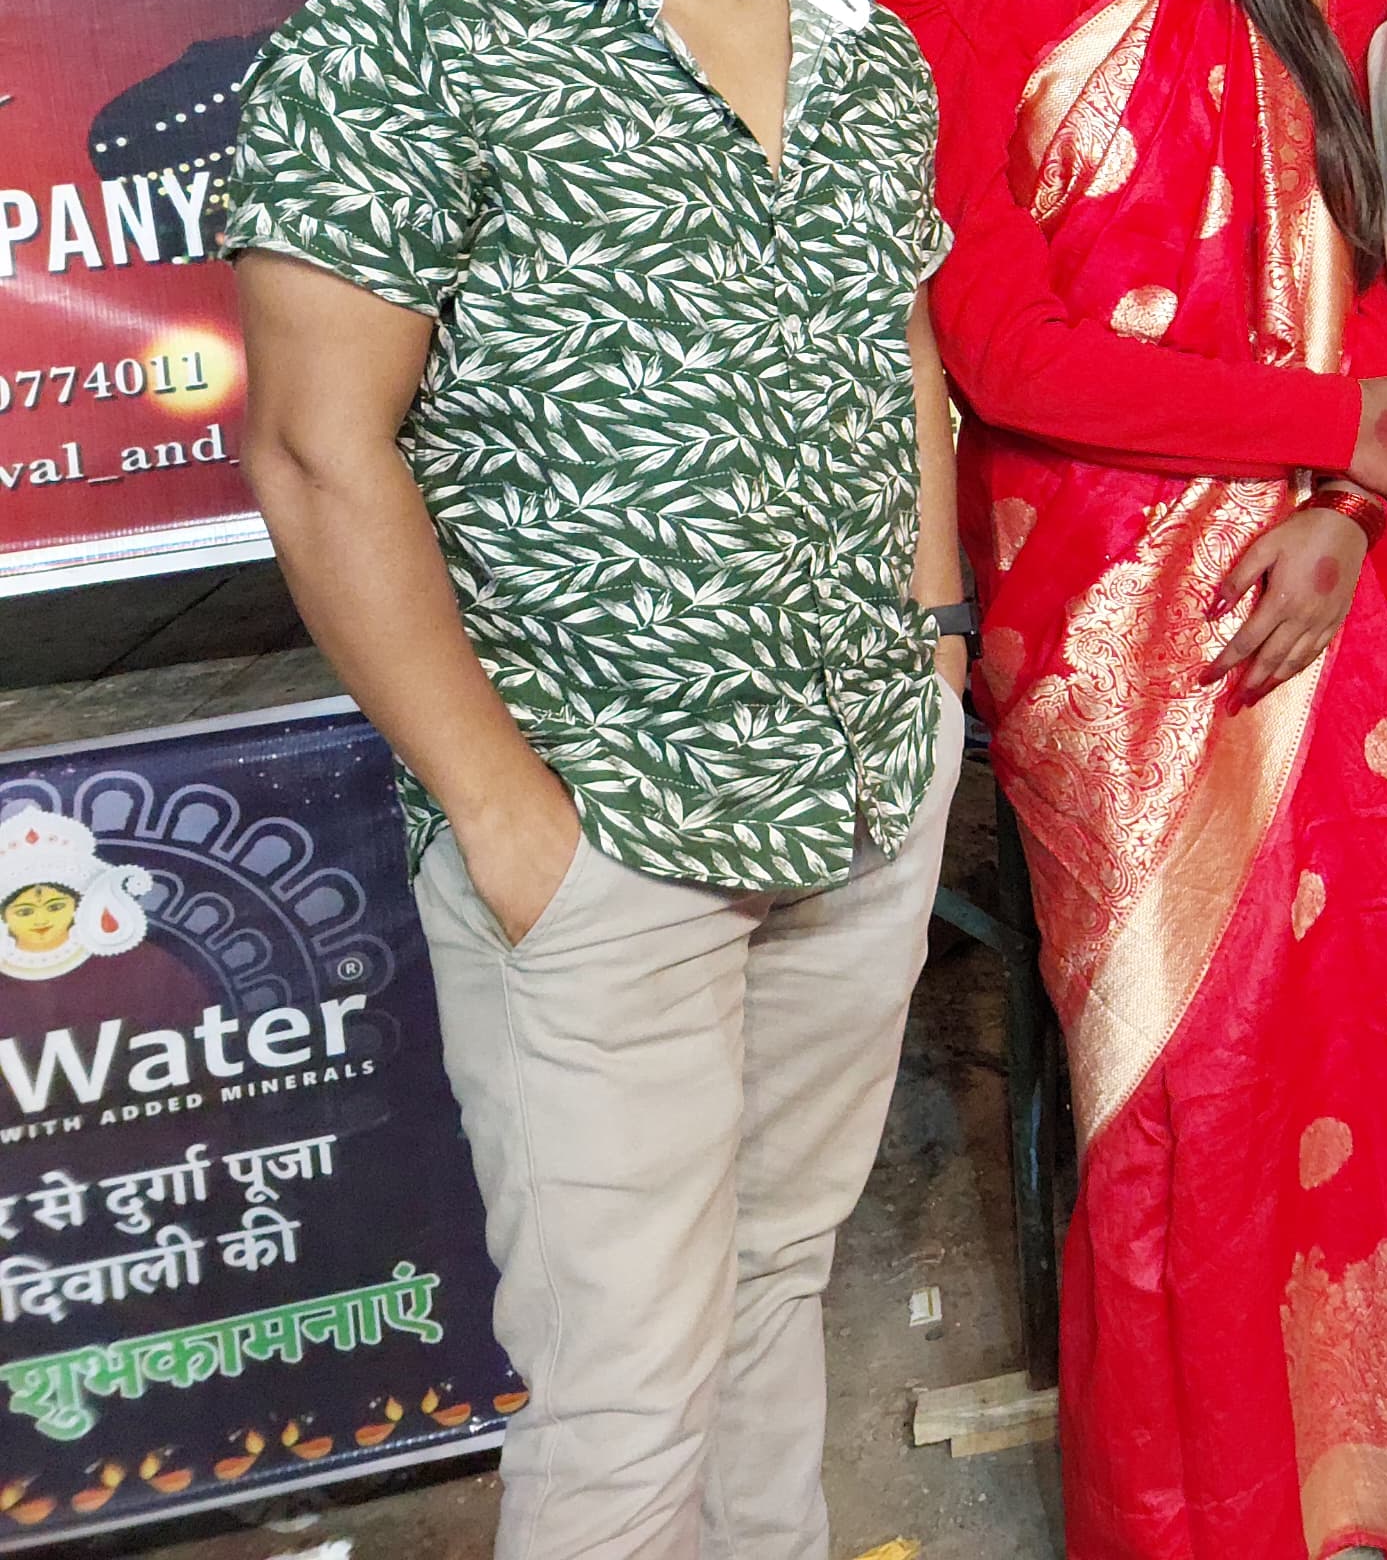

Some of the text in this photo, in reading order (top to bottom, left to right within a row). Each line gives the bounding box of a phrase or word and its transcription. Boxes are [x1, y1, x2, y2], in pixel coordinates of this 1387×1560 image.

[0, 171, 210, 279] PANY
[0, 992, 367, 1114] Water
[0, 1059, 375, 1143] WITH ADDED MINERALS
[27, 1170, 89, 1231] से
[99, 1143, 212, 1235] दुर्गा
[222, 1134, 337, 1203] पूजा
[0, 1206, 301, 1324] दिवाली की
